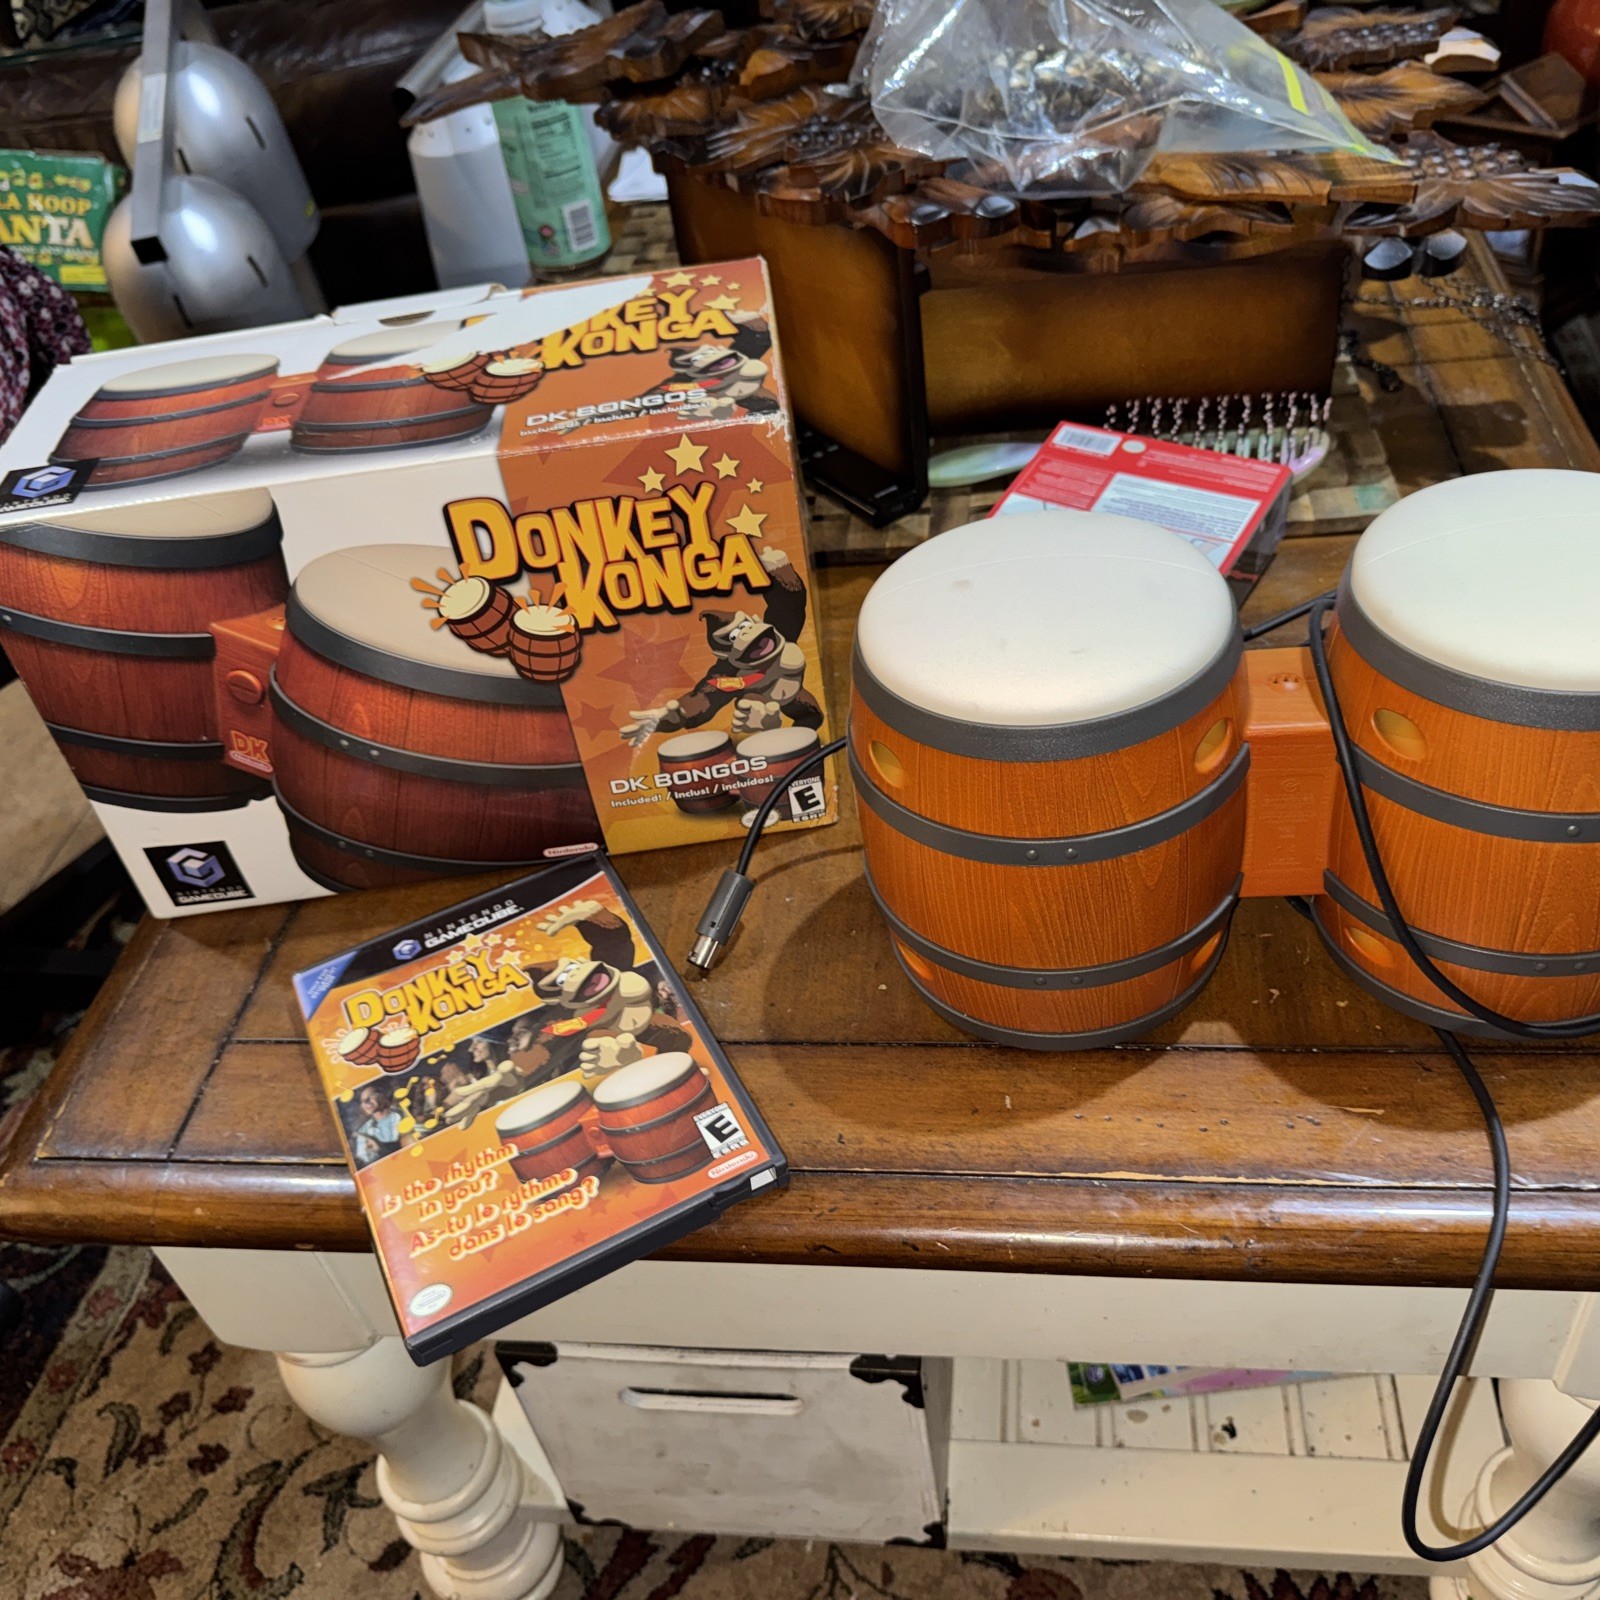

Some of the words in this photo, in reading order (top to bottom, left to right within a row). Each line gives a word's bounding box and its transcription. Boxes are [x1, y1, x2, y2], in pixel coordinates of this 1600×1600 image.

[541, 310, 740, 370] KONGA
[526, 409, 571, 427] DK
[576, 388, 708, 418] BONGOS
[446, 481, 717, 583] DONKEY
[558, 533, 772, 632] KONGA
[230, 729, 270, 763] DK
[610, 776, 651, 795] DK
[654, 756, 769, 789] BONGOS
[611, 793, 662, 808] Included!
[665, 791, 672, 801] /
[675, 785, 710, 800] Inclus!
[712, 783, 719, 794] /
[790, 775, 821, 788] VERYONE
[793, 785, 821, 812] E
[423, 899, 515, 940] NINTENDO
[424, 904, 521, 949] GAMECUBE
[346, 948, 492, 1028] DONKEY
[406, 963, 529, 1036] KONGA
[705, 1114, 739, 1143] E
[381, 1194, 402, 1218] Is
[402, 1178, 442, 1205] the
[443, 1143, 519, 1188] rhythm
[418, 1200, 443, 1222] in
[443, 1169, 499, 1214] you?
[409, 1214, 473, 1259] As-tu
[473, 1203, 500, 1228] le
[500, 1168, 579, 1215] rythme
[505, 1212, 532, 1236] le
